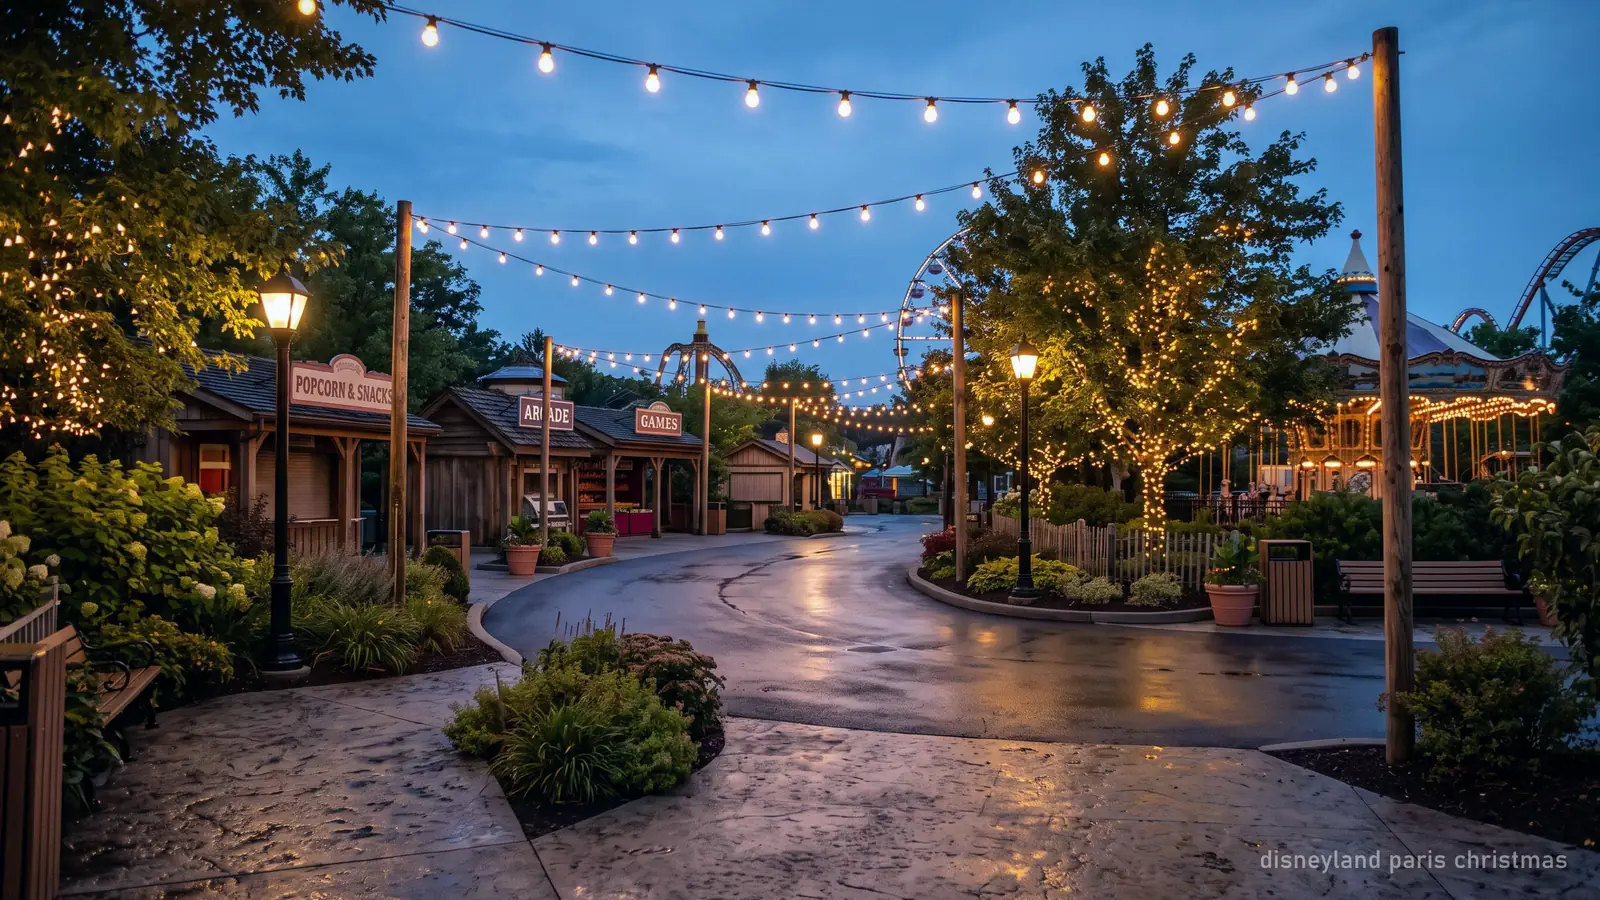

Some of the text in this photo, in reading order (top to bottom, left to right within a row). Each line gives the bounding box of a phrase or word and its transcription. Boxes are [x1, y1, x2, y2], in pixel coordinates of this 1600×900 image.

[296, 375, 345, 399] POPCORN
[348, 383, 355, 400] &
[641, 414, 678, 430] GAMES
